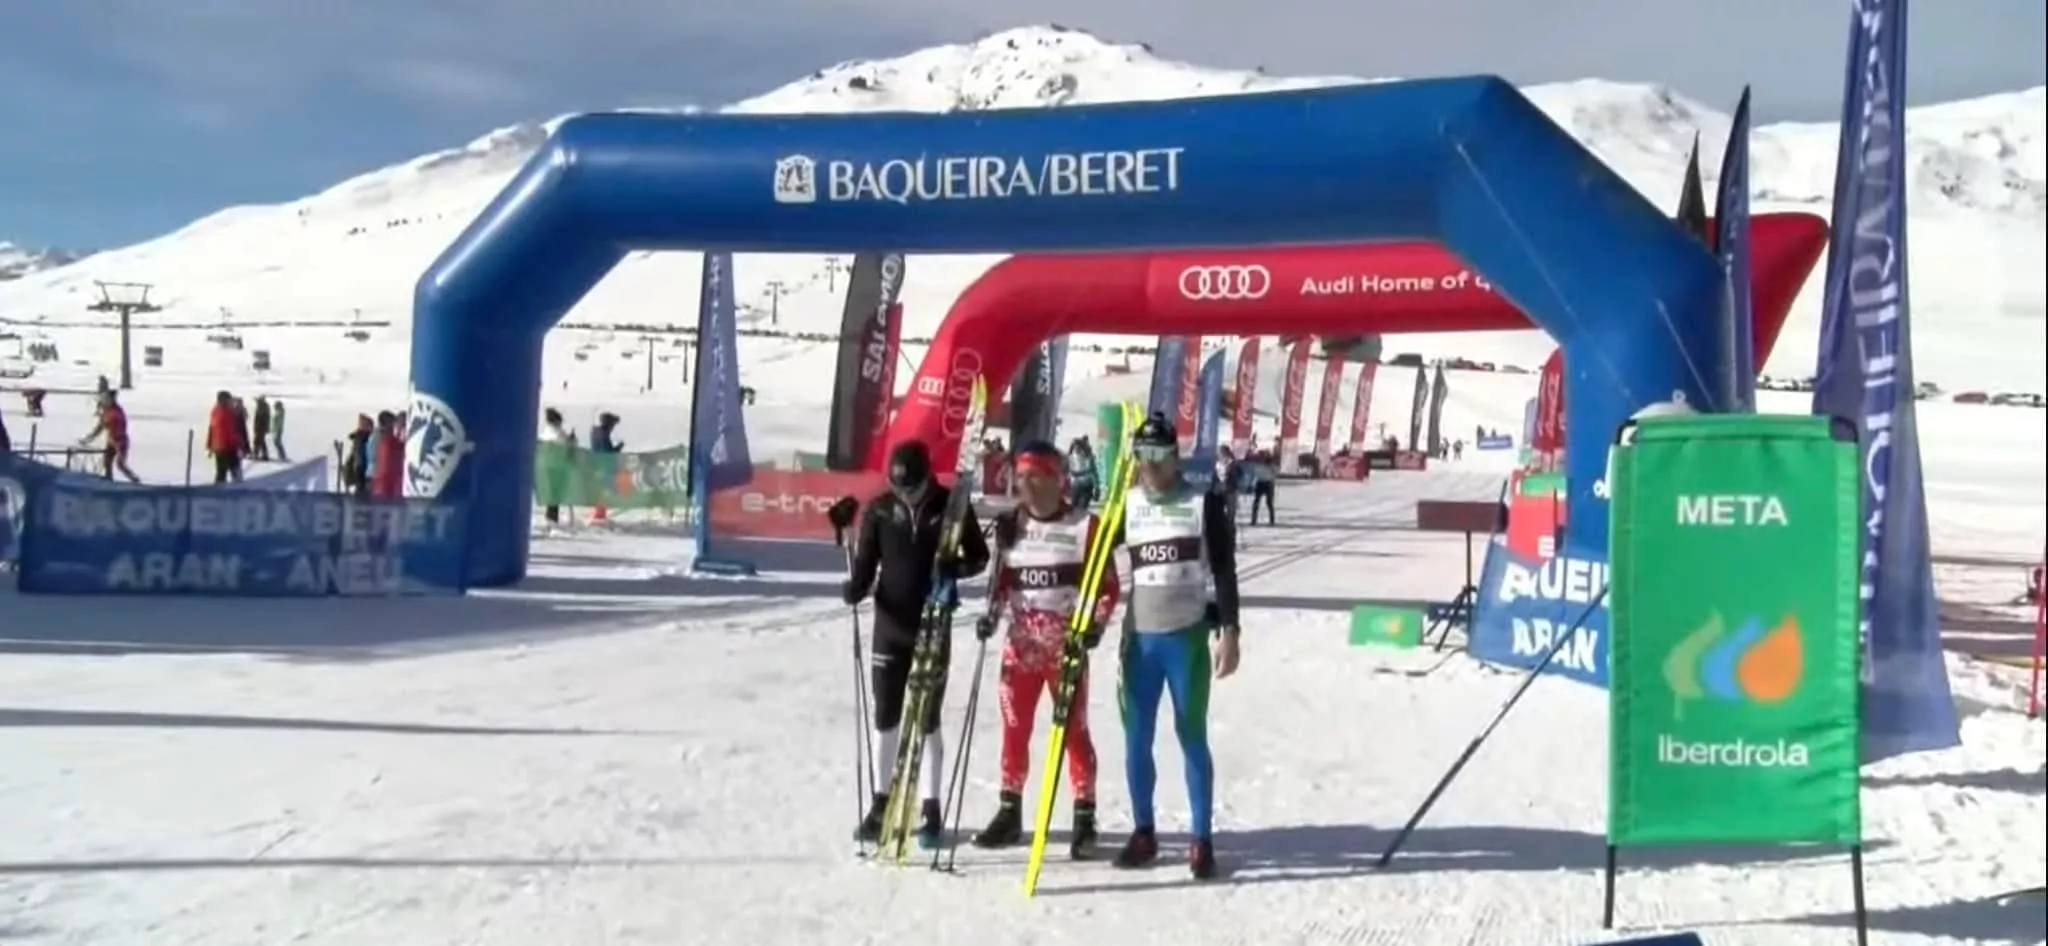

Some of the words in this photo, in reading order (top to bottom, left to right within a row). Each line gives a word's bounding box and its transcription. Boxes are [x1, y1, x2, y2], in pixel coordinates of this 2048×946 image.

[829, 147, 1185, 205] BAQUEIRA/BERET
[1299, 276, 1354, 295] Audi
[1361, 274, 1435, 293] Home
[1440, 270, 1469, 290] of
[1676, 494, 1788, 526] META
[1139, 545, 1178, 562] 4050
[107, 552, 241, 590] ARAN
[1019, 569, 1058, 586] 4001
[1512, 617, 1599, 673] ARAN
[1658, 734, 1809, 767] Iberdrola
